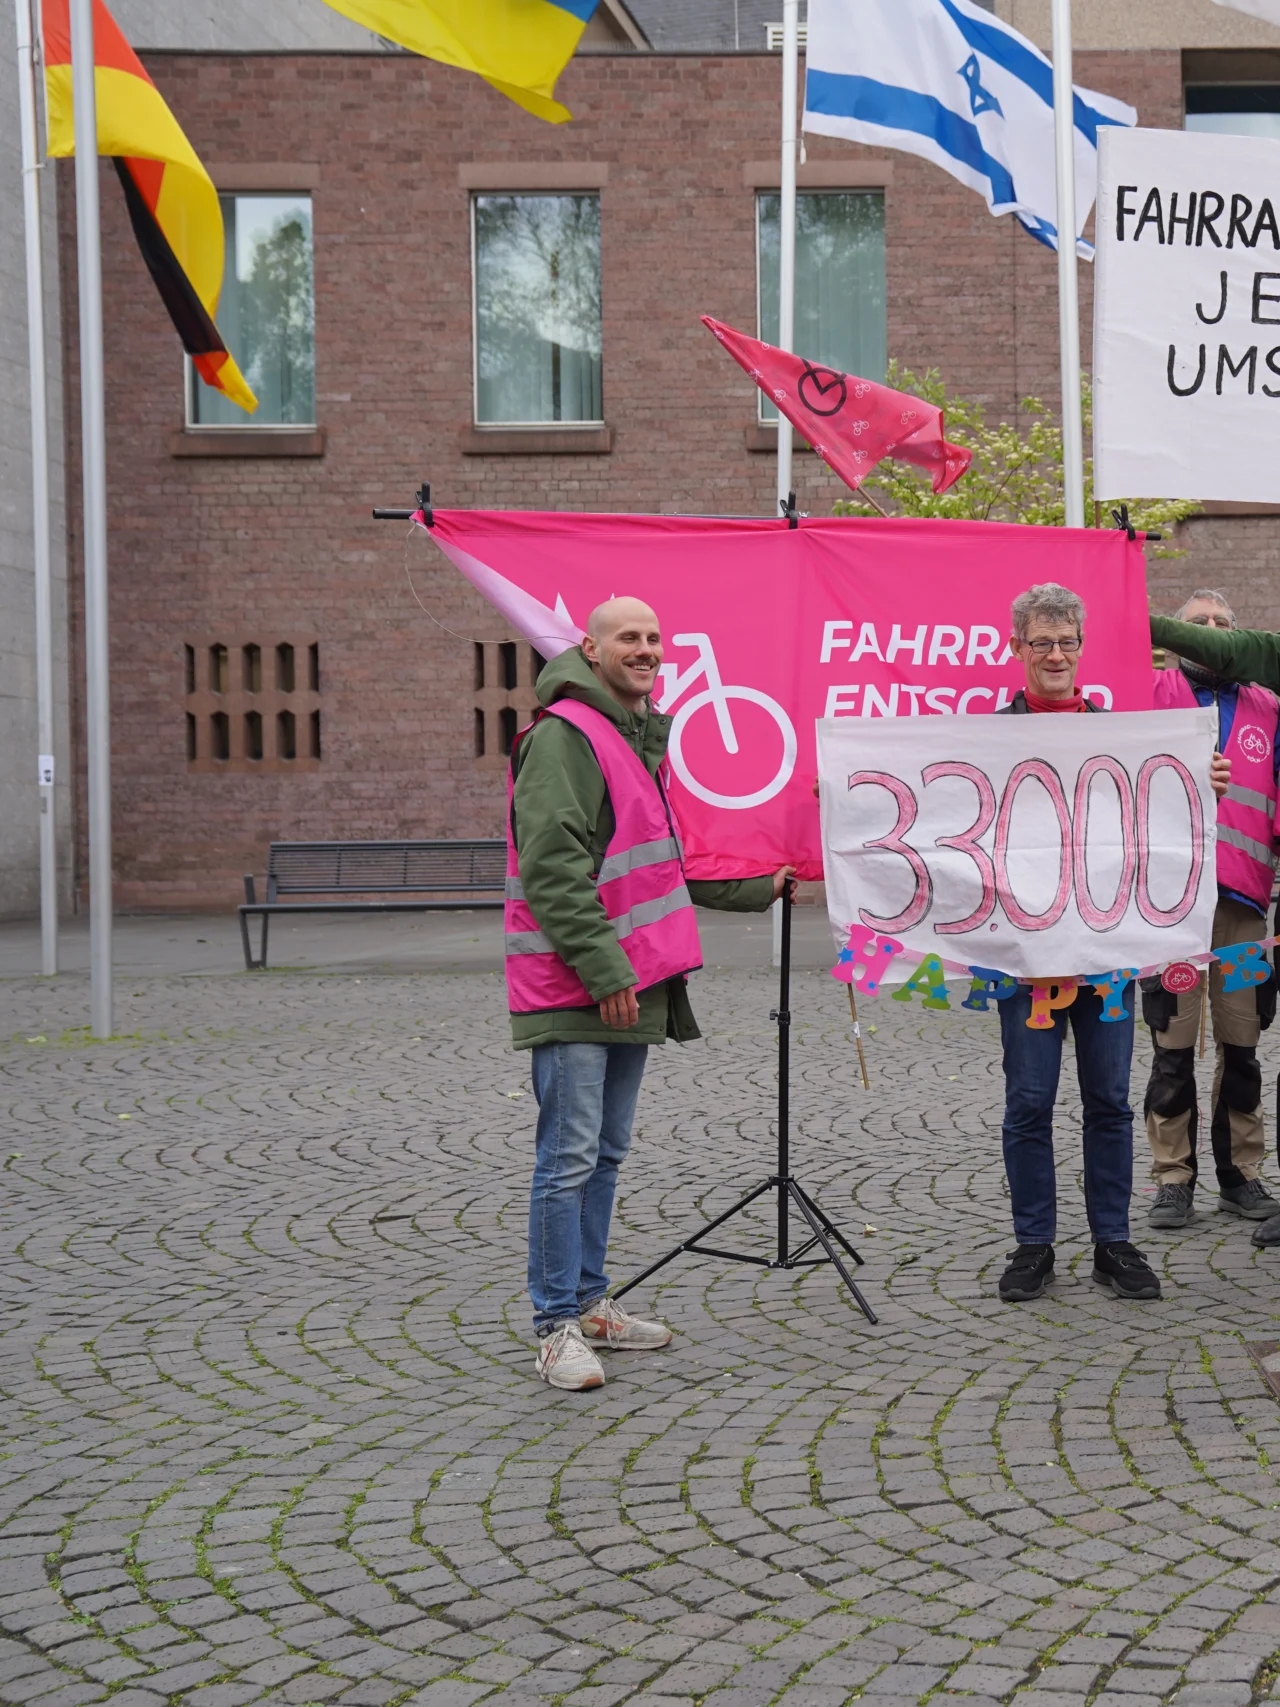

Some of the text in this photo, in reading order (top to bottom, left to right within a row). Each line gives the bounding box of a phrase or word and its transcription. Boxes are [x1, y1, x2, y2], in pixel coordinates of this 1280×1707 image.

[820, 620, 1014, 666] FAHRR
[848, 753, 1204, 935] 33.000
[831, 923, 1139, 1030] HAPPY
